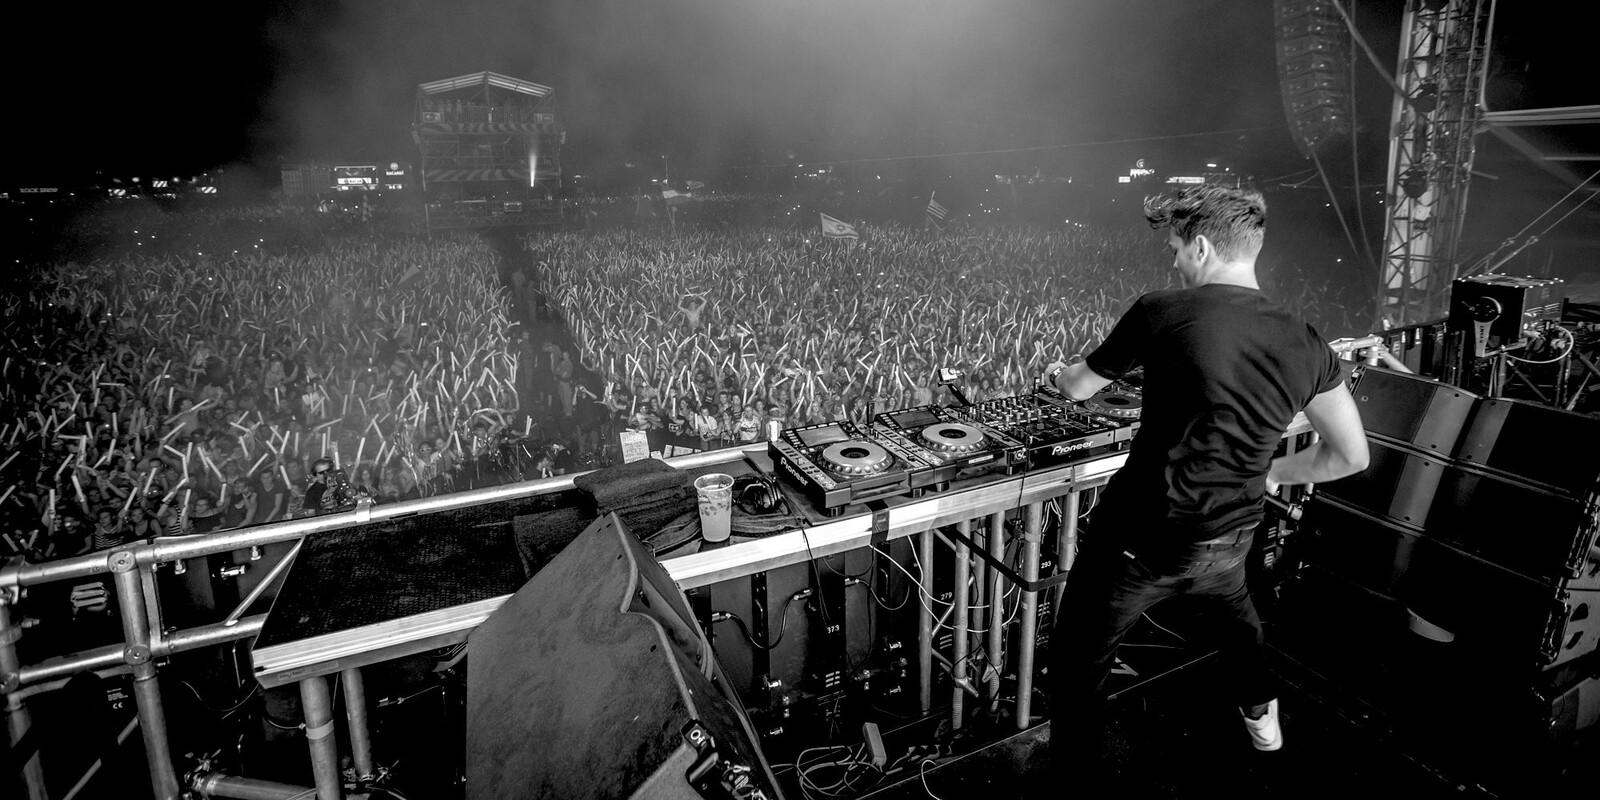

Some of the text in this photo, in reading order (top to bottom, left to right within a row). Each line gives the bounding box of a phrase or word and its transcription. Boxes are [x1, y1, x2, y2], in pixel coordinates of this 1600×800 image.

[1051, 441, 1094, 456] Pioneer
[780, 457, 809, 486] Pioneer
[940, 591, 953, 601] 279
[826, 624, 840, 634] 373
